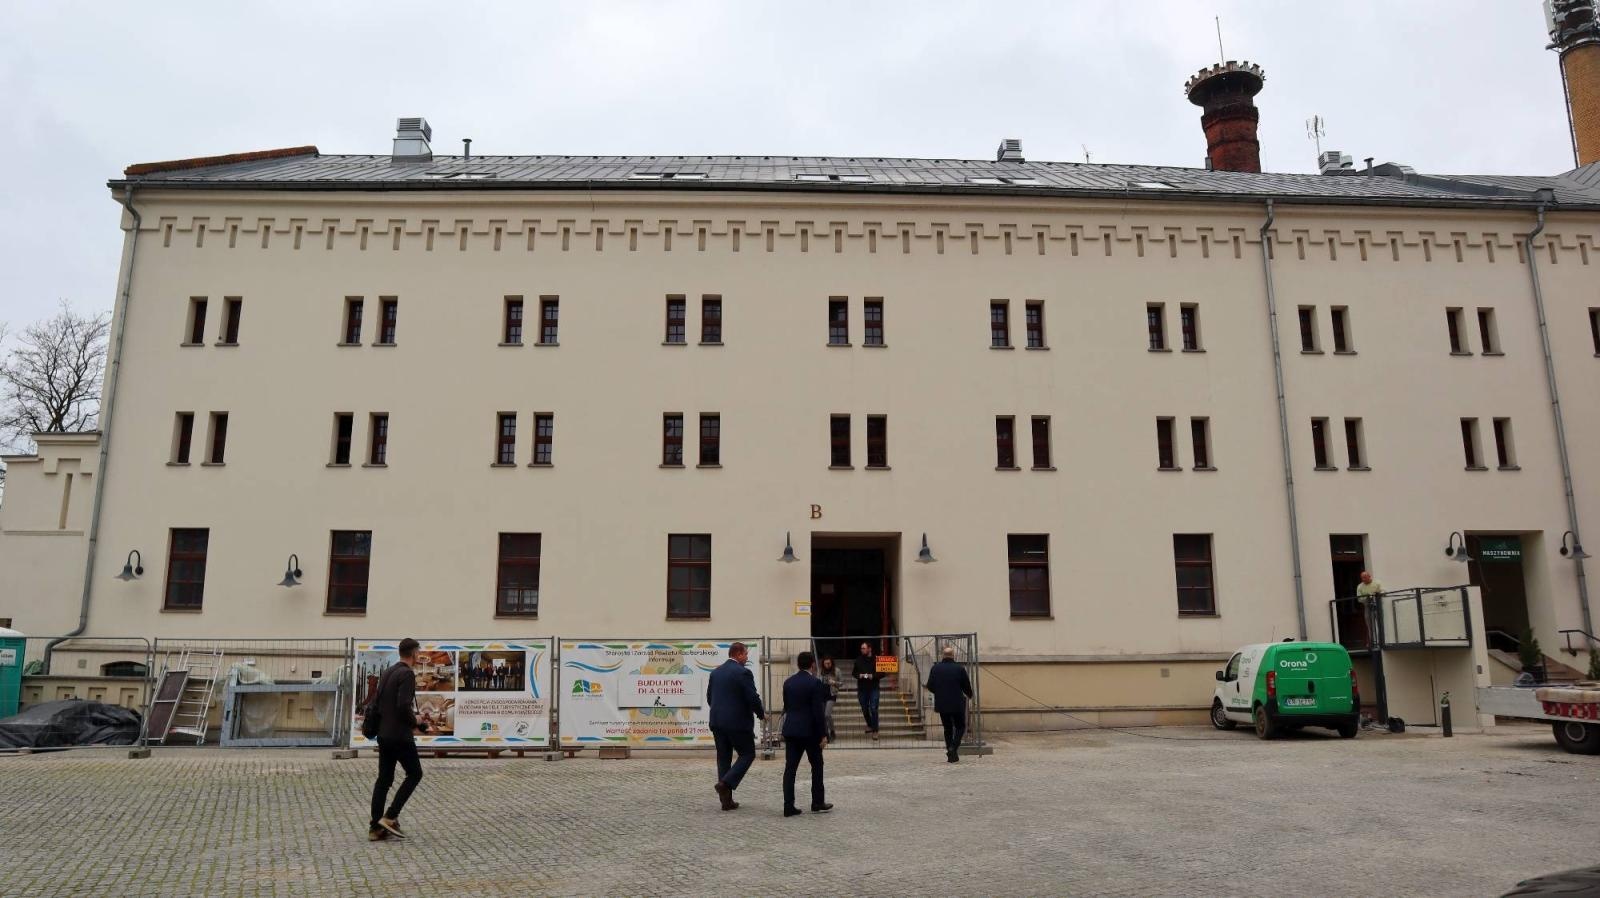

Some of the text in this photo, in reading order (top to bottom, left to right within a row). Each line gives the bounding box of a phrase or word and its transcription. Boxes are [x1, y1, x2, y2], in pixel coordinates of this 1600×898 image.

[810, 504, 822, 519] B
[1280, 660, 1308, 668] Orona
[667, 727, 688, 735] ponad
